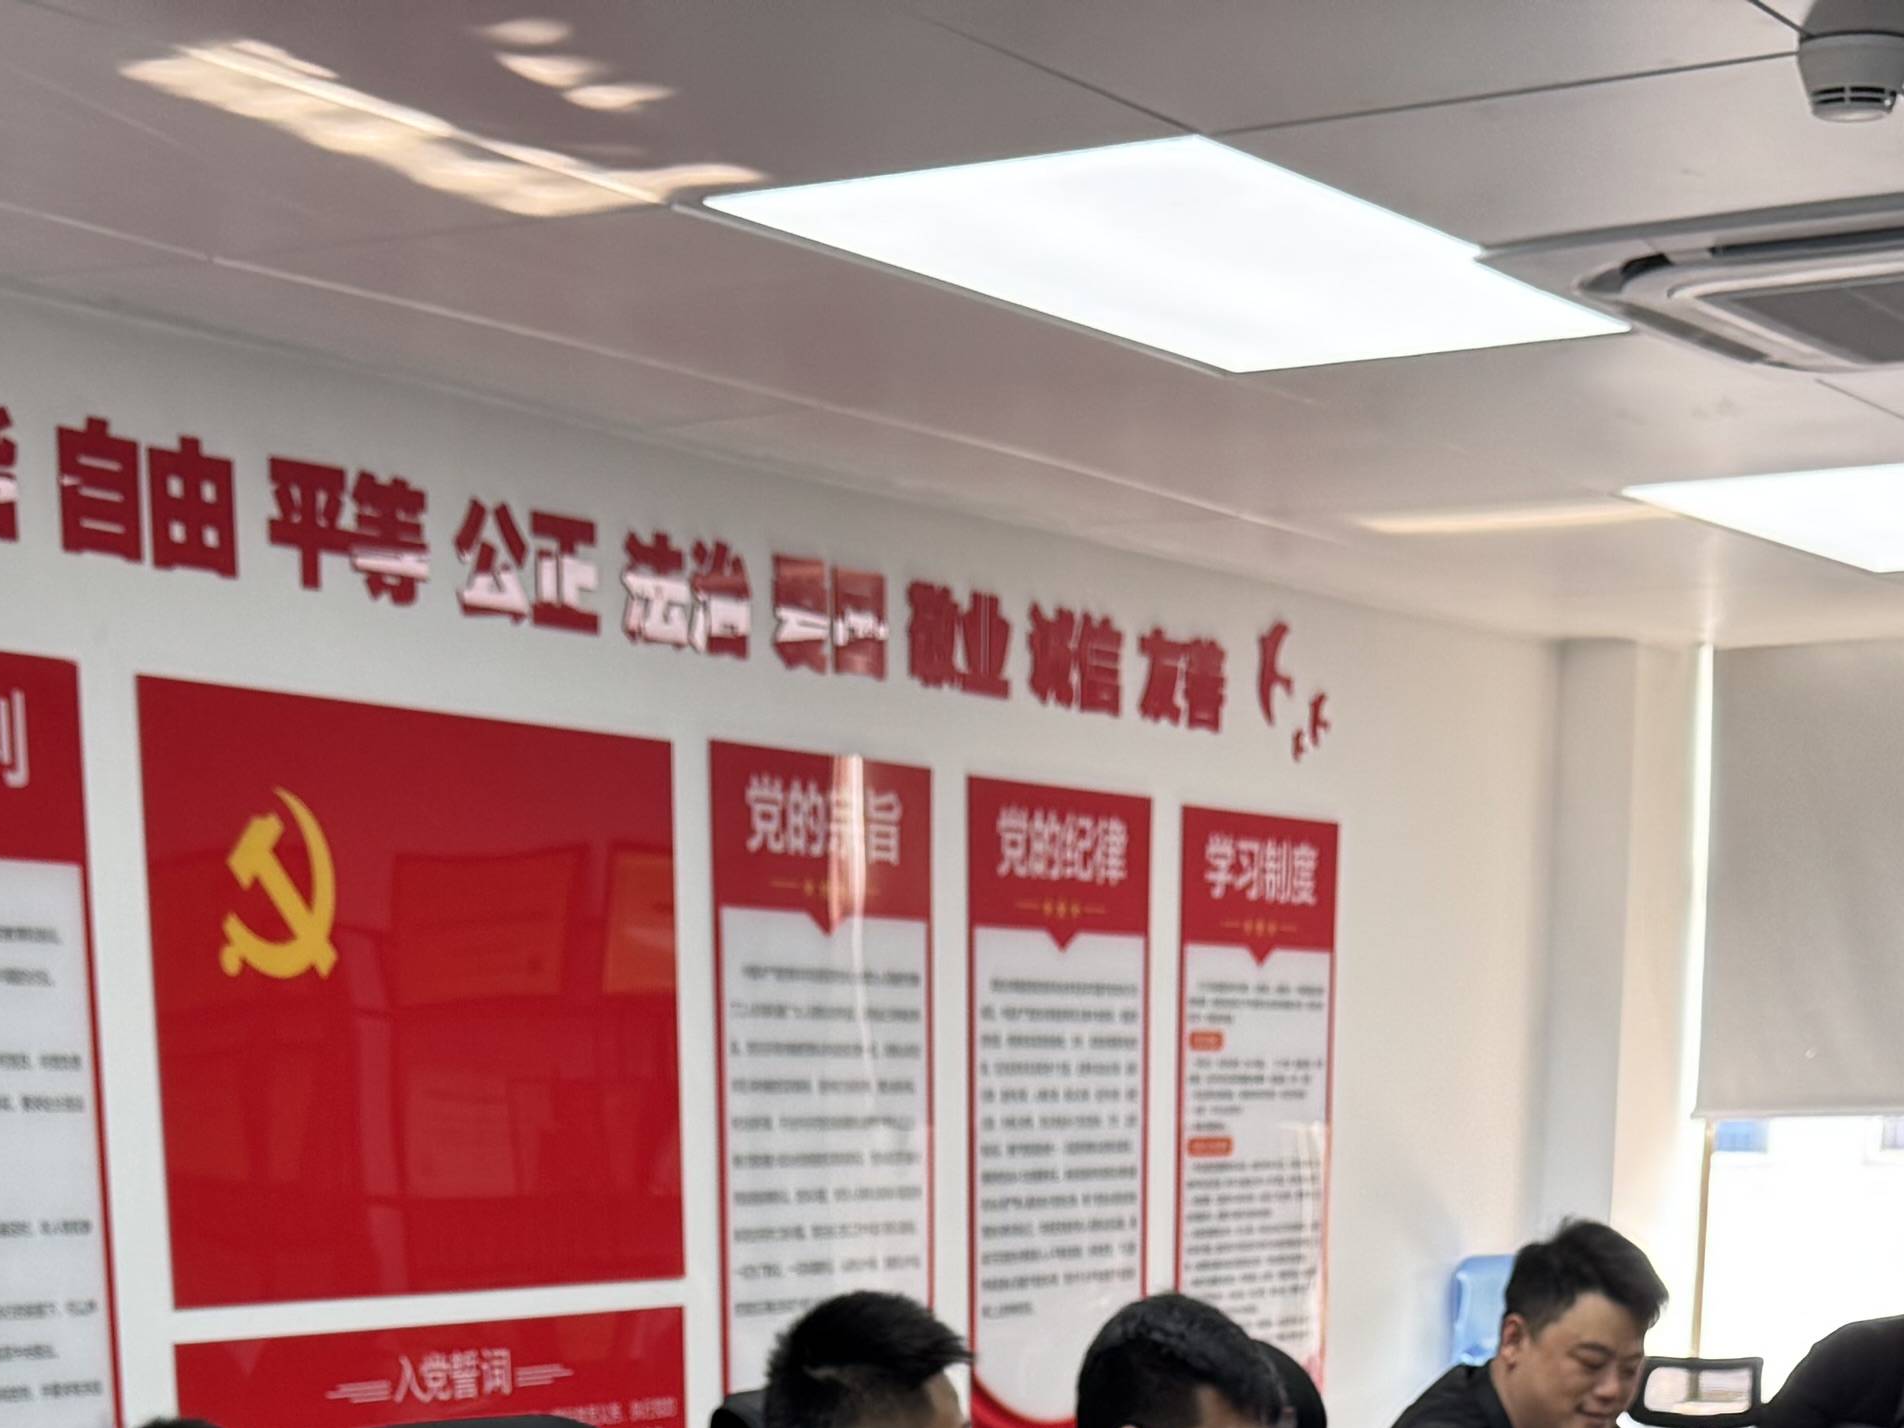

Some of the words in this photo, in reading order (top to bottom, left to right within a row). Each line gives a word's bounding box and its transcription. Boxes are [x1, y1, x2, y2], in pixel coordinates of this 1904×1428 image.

[57, 417, 238, 577] 自由
[267, 455, 430, 607] 平等
[455, 499, 600, 634] 公正
[622, 530, 752, 660] 法治
[907, 579, 1010, 699] 敬业
[1030, 602, 1123, 717] 诚信
[1138, 625, 1226, 733] 友善
[996, 807, 1129, 886] 党的纪律
[1203, 832, 1320, 906] 学习制度
[393, 1348, 514, 1403] 入党誓词
